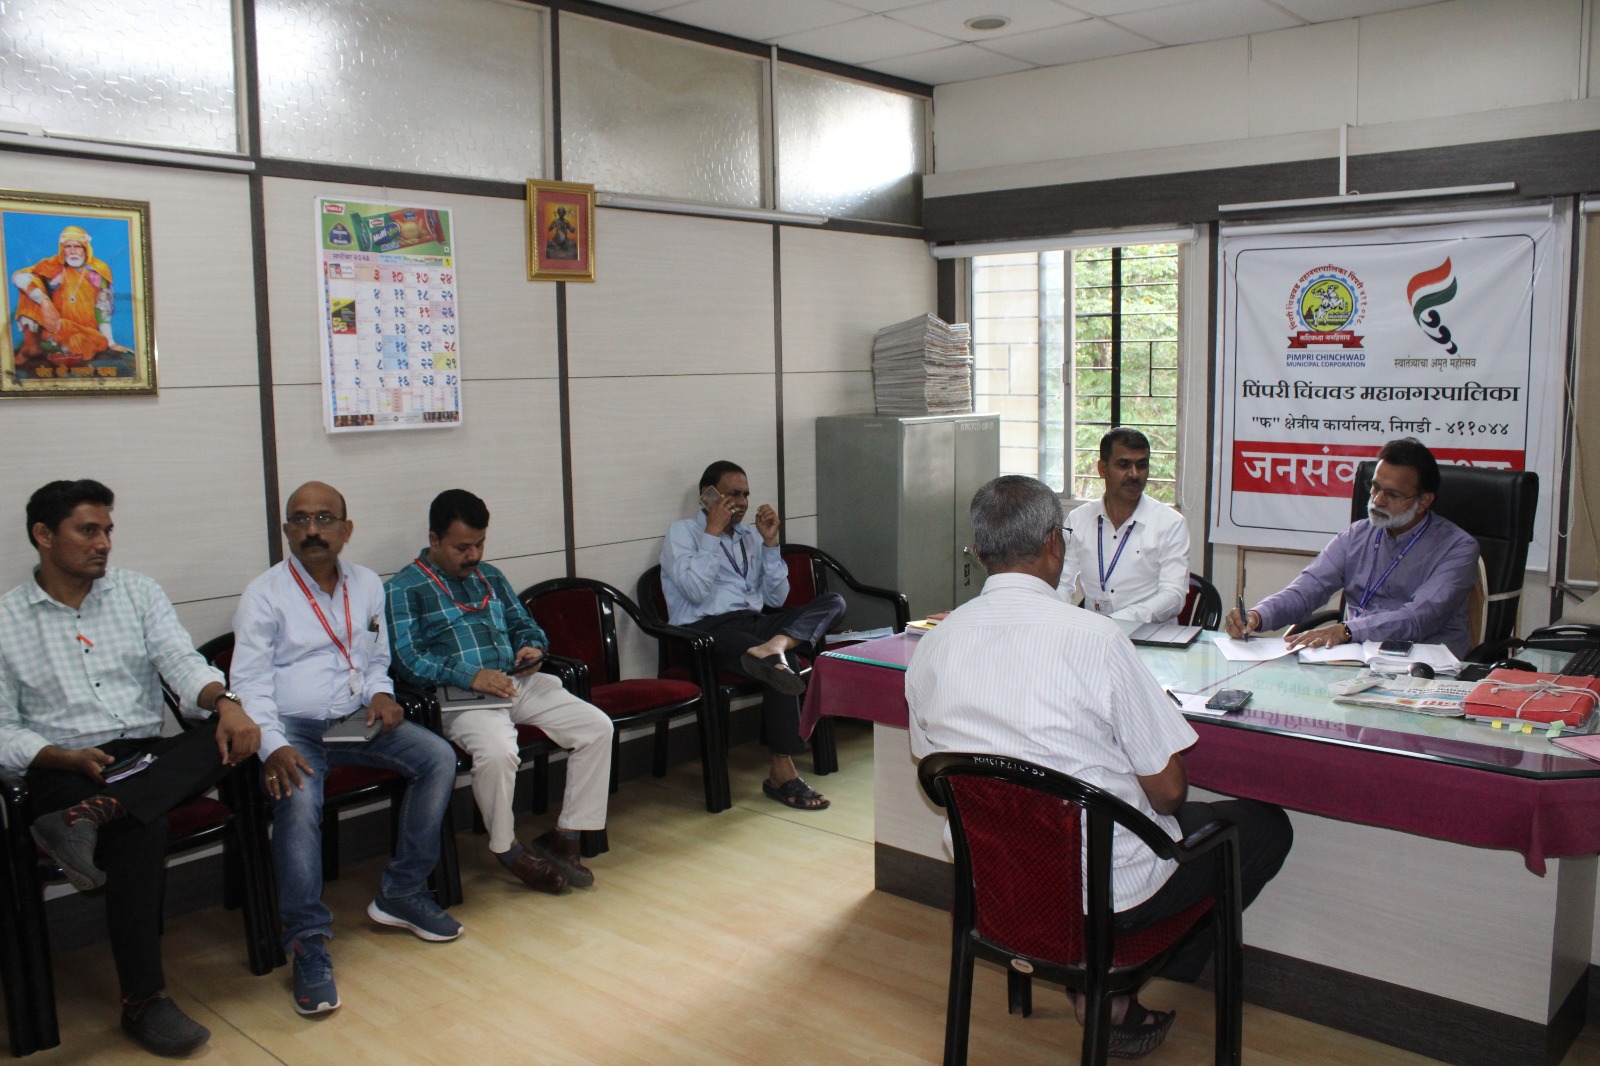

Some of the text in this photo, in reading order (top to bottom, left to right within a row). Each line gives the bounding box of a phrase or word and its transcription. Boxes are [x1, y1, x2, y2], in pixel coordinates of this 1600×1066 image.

[1287, 353, 1365, 361] PIMPRI CHINCHWAD
[1449, 355, 1477, 368] महोत्सव
[1242, 379, 1521, 402] पिंपरी चिंचवड महानगरपालिका
[1284, 413, 1319, 431] क्षेत्रीय
[1389, 415, 1431, 433] निगडी
[1446, 422, 1510, 436] ४११०४४
